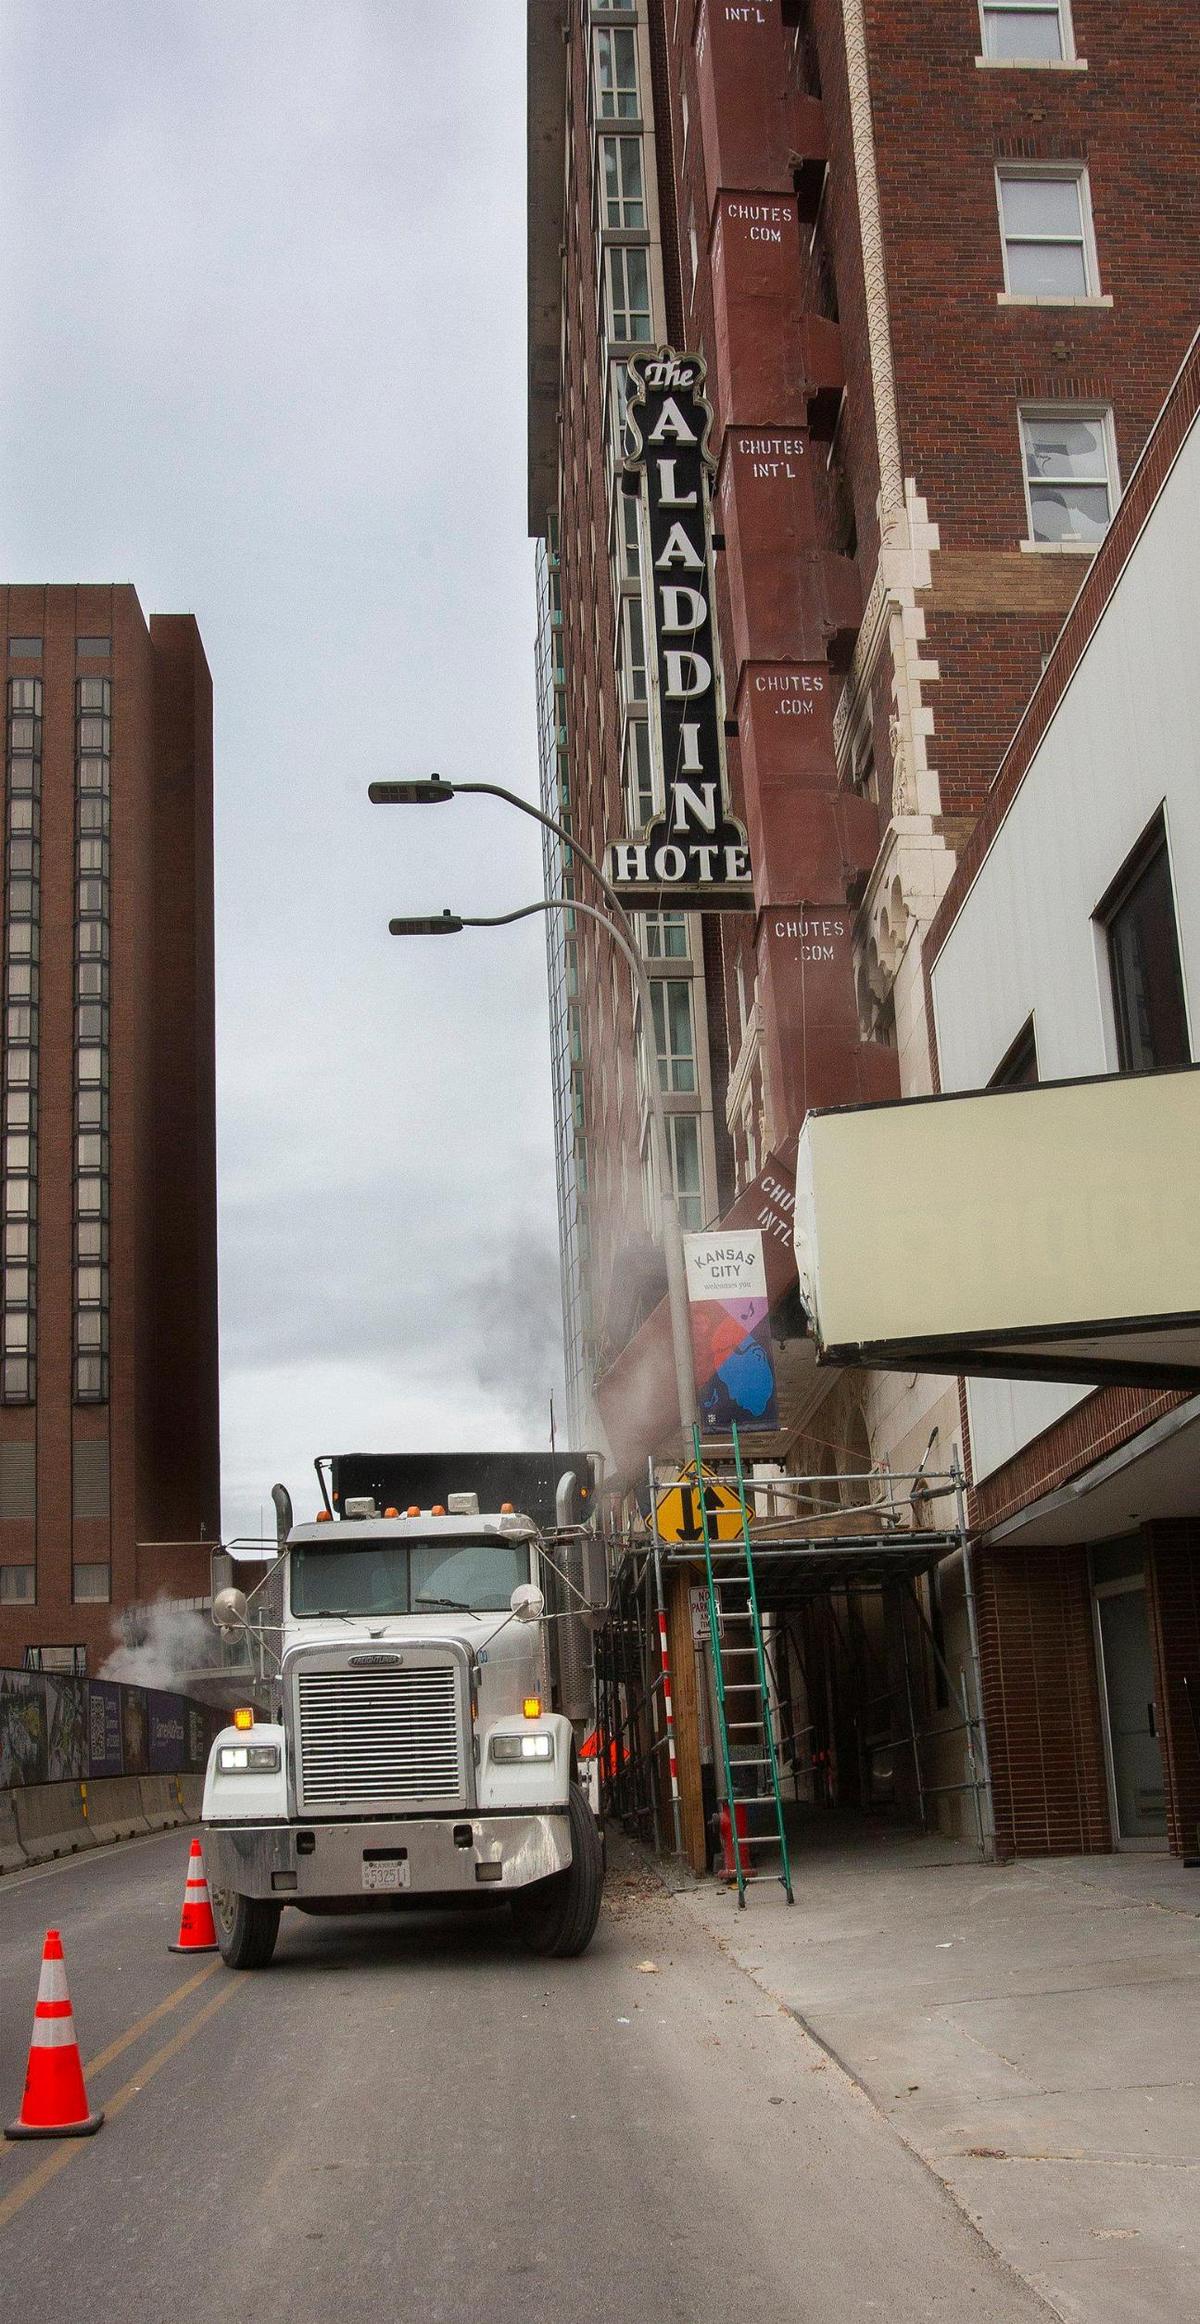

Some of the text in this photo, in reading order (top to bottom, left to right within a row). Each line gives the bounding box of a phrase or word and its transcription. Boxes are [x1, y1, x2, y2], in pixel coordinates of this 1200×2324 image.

[725, 7, 765, 22] INT'L
[728, 204, 792, 222] CHUTES
[744, 227, 781, 243] .COM
[645, 360, 694, 391] The
[739, 439, 804, 455] CHUTES
[753, 461, 796, 478] INT'L
[649, 396, 717, 834] ALADDIN
[755, 675, 824, 692] CHUTES
[775, 699, 814, 714] .COM
[615, 845, 751, 881] HOTE
[775, 921, 844, 937] CHUTES
[794, 945, 834, 960] .COM
[761, 1176, 796, 1217] CHU
[694, 1249, 756, 1269] KANSAS
[711, 1265, 741, 1277] CITY
